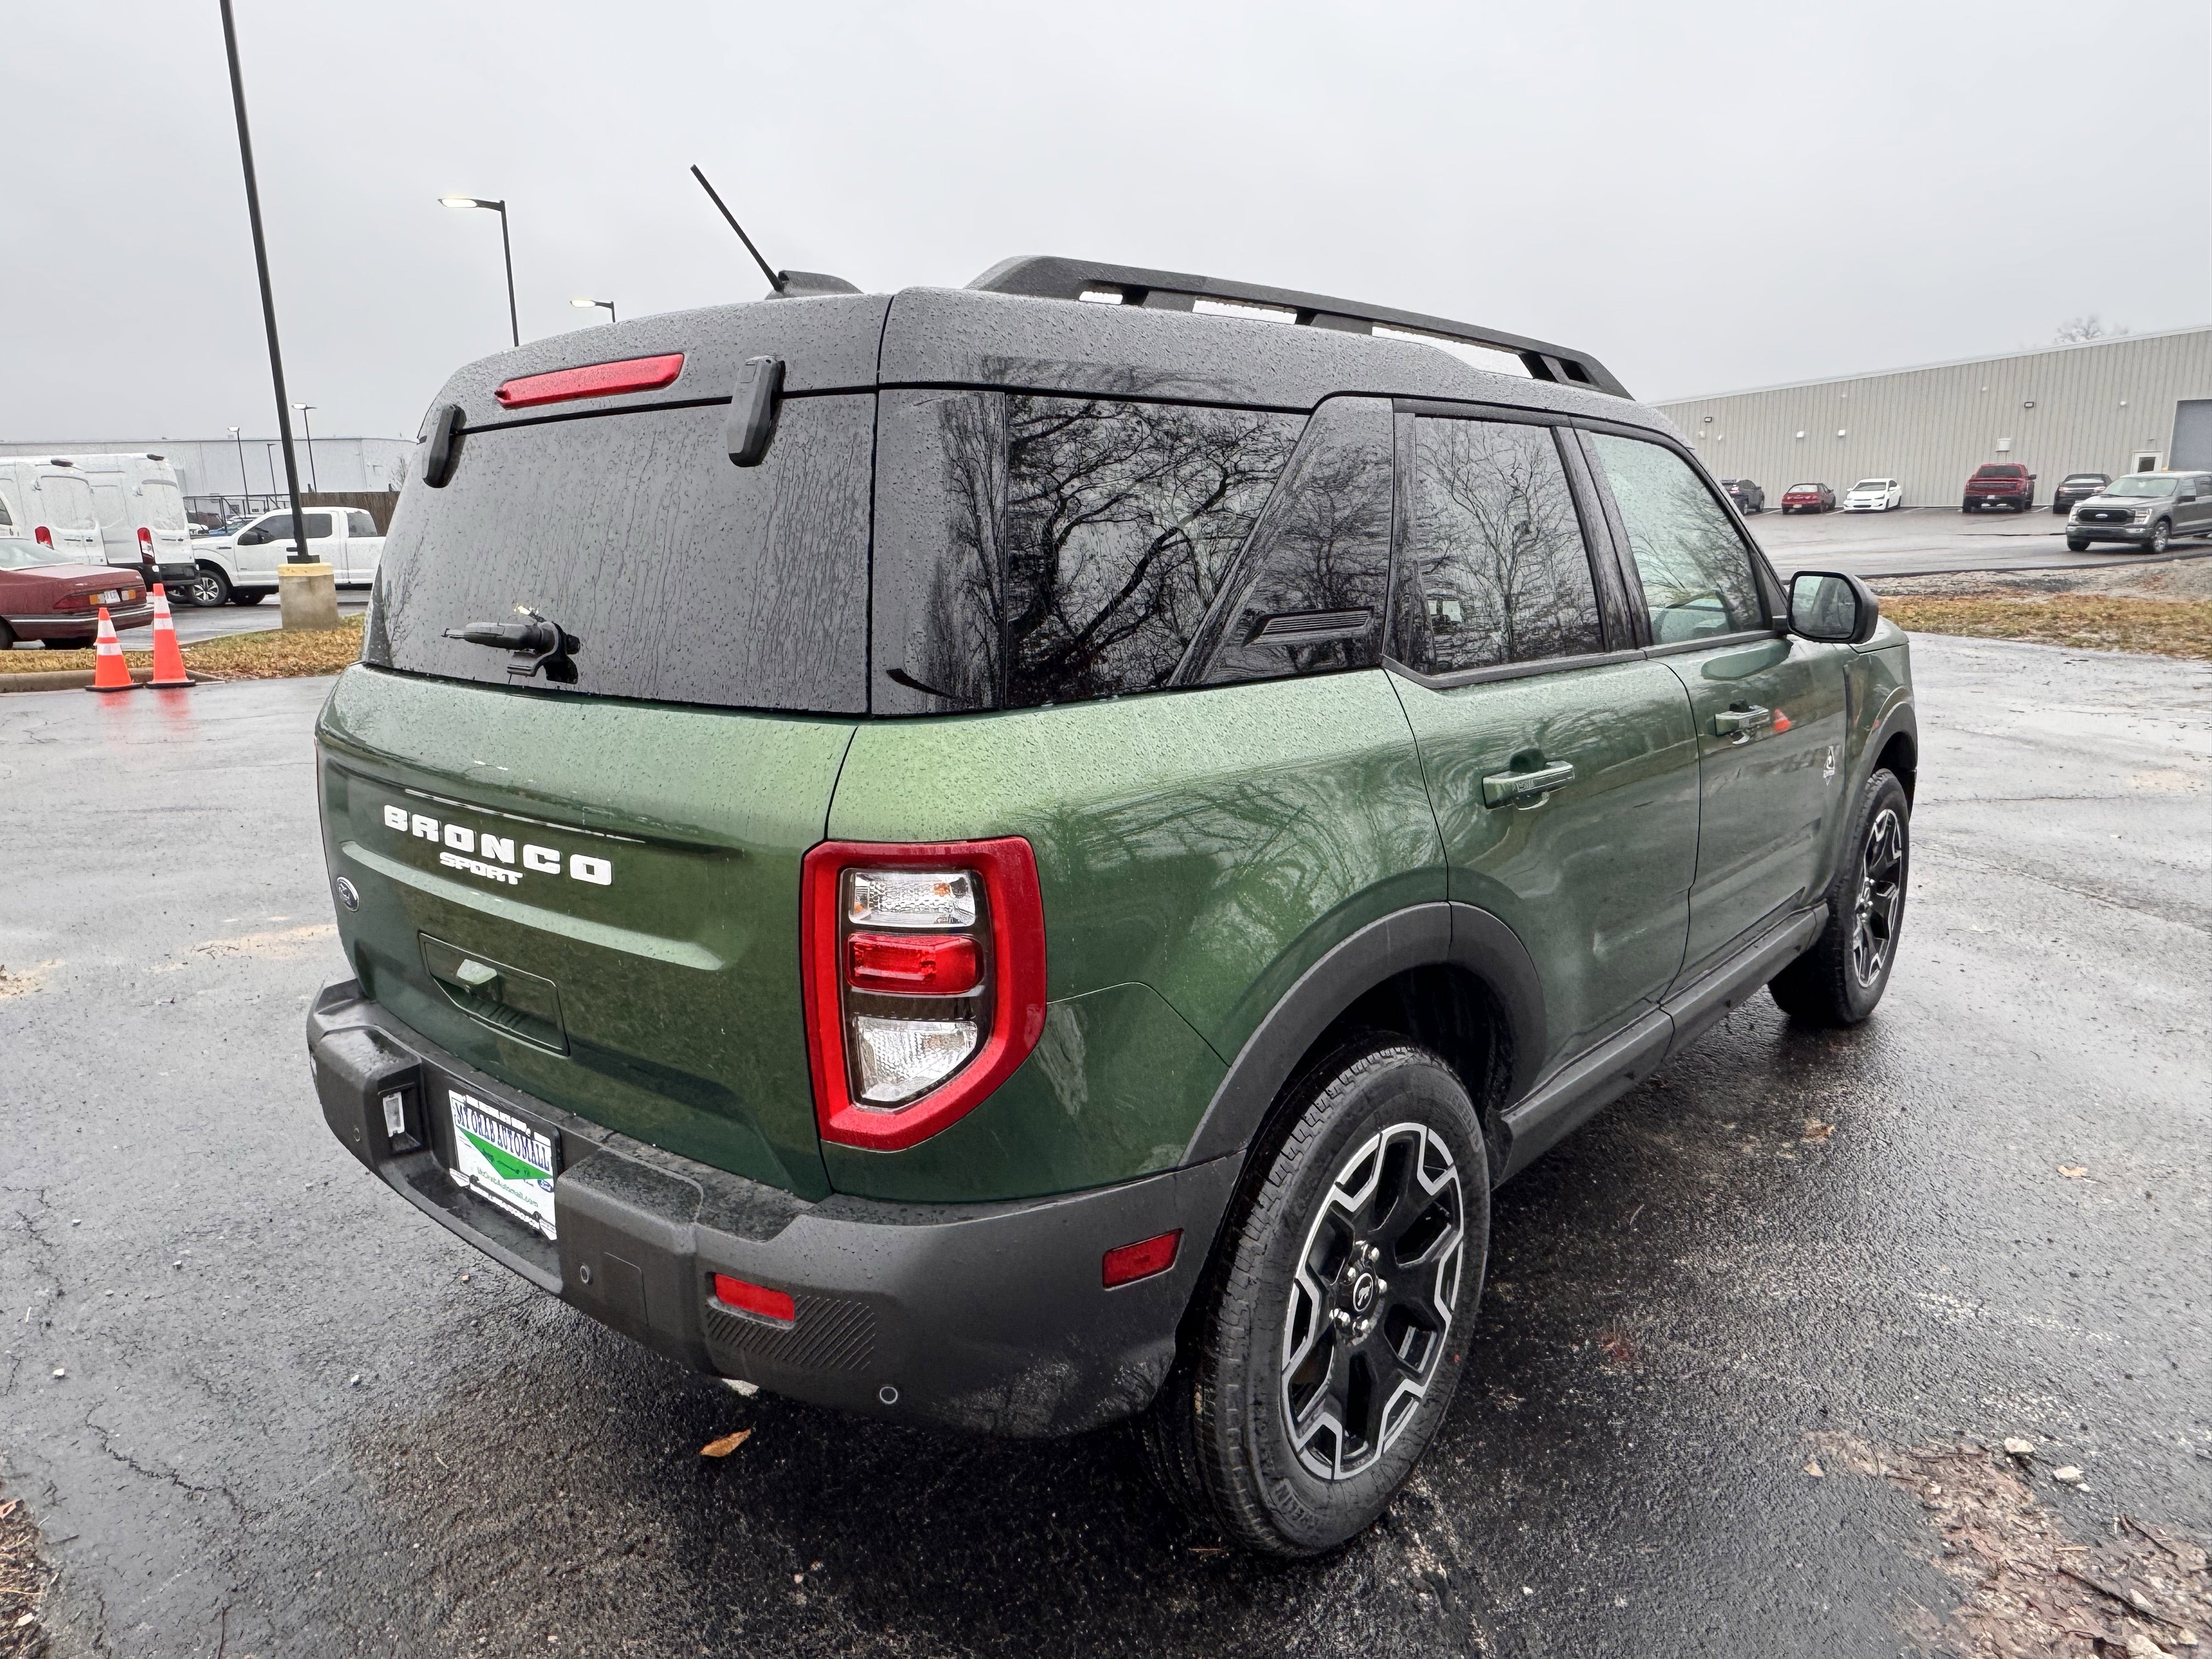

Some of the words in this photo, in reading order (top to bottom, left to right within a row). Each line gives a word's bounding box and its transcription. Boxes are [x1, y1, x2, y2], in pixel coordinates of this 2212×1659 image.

[384, 804, 612, 885] BRONCO
[439, 851, 523, 885] SPORT
[496, 1122, 550, 1172] AUTOMALL
